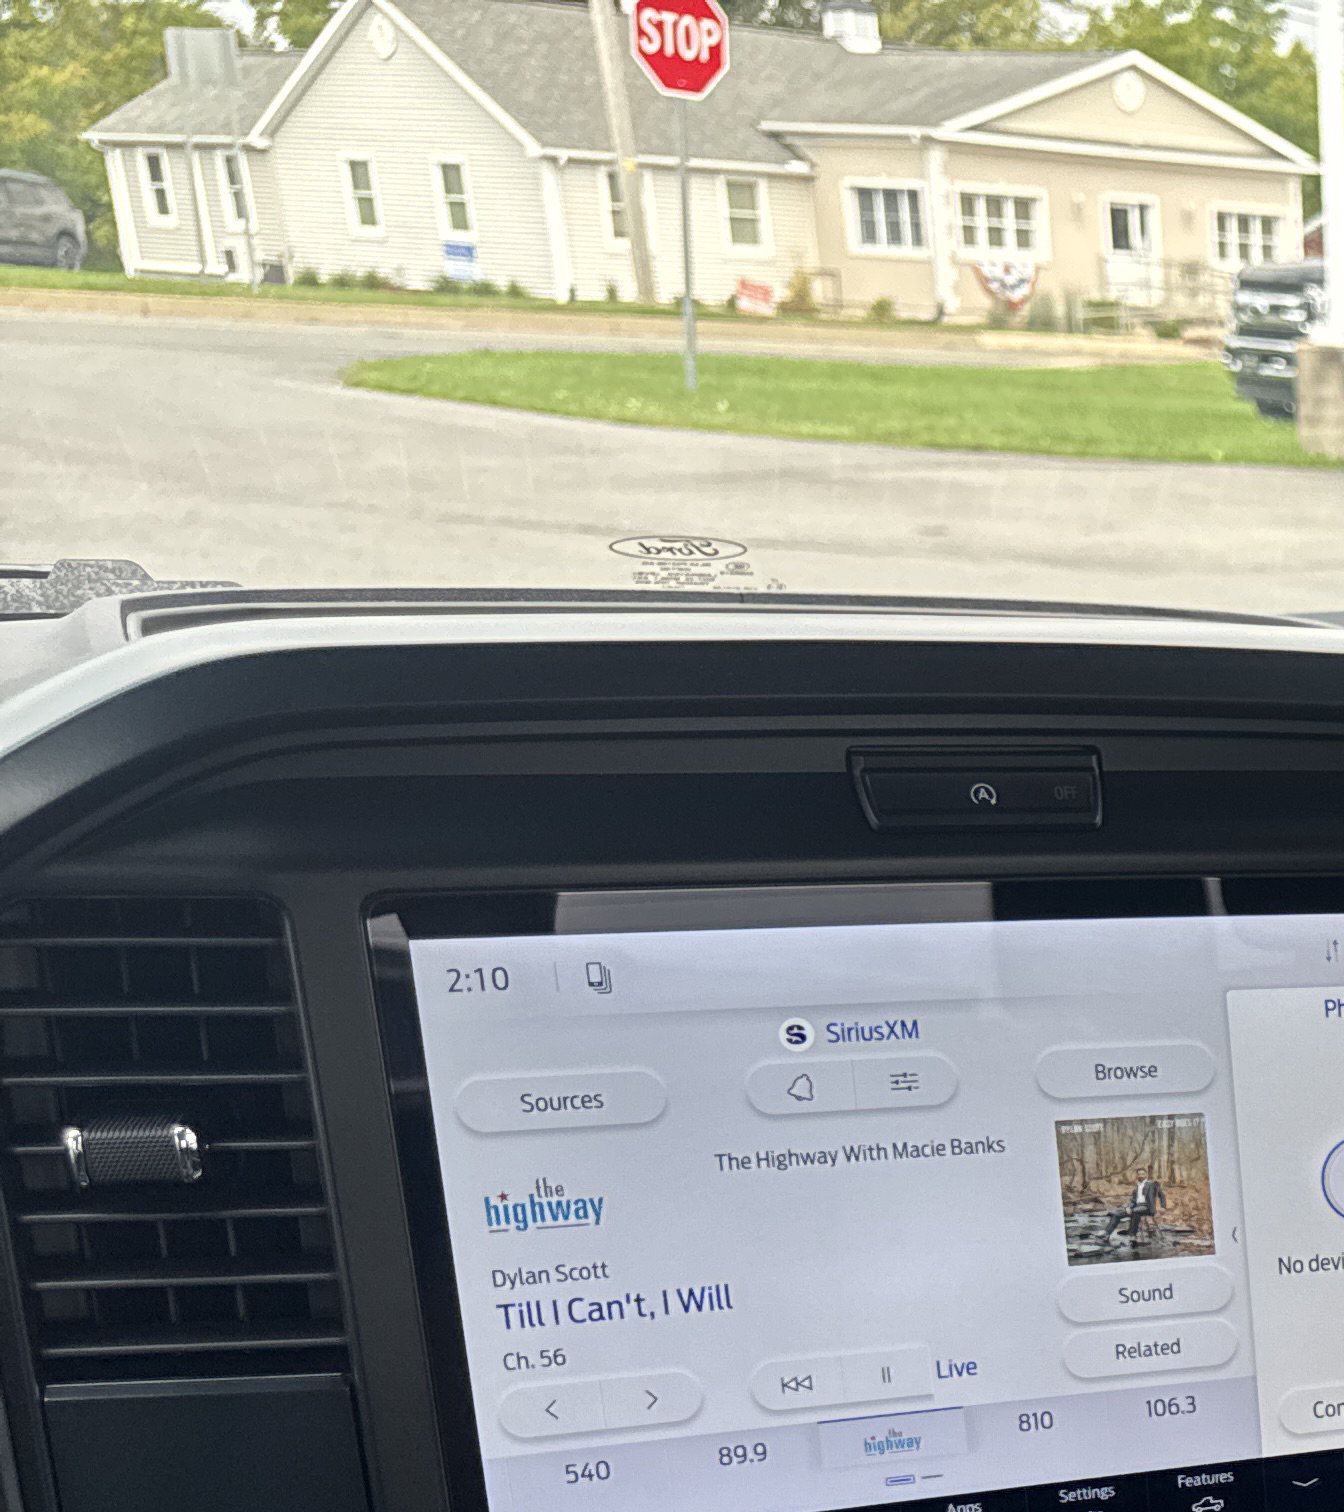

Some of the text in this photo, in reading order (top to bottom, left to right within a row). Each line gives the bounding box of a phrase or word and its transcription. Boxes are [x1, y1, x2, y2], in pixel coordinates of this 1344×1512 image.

[640, 6, 721, 63] STOP
[1054, 786, 1078, 800] OFF
[446, 966, 510, 993] 2:10
[825, 1019, 920, 1044] SiriusXM
[1095, 1063, 1158, 1081] Browse
[520, 1090, 604, 1113] Sources
[715, 1136, 1006, 1172] The Highway With Macie Banks
[535, 1177, 565, 1198] the
[484, 1194, 604, 1231] highway
[492, 1262, 610, 1290] Dylan Scott
[1278, 1256, 1304, 1275] No
[1118, 1283, 1174, 1304] Sound
[496, 1284, 734, 1331] Till I Can't, I Will
[503, 1349, 567, 1371] Ch. 56
[1115, 1338, 1181, 1360] Related
[935, 1359, 978, 1380] Live
[1145, 1395, 1197, 1417] 106.3
[1018, 1411, 1054, 1432] 810
[718, 1443, 768, 1466] 89.9
[864, 1436, 921, 1455] highway
[564, 1461, 611, 1484] 540
[1177, 1469, 1234, 1489] Features
[1058, 1484, 1116, 1505] Settings
